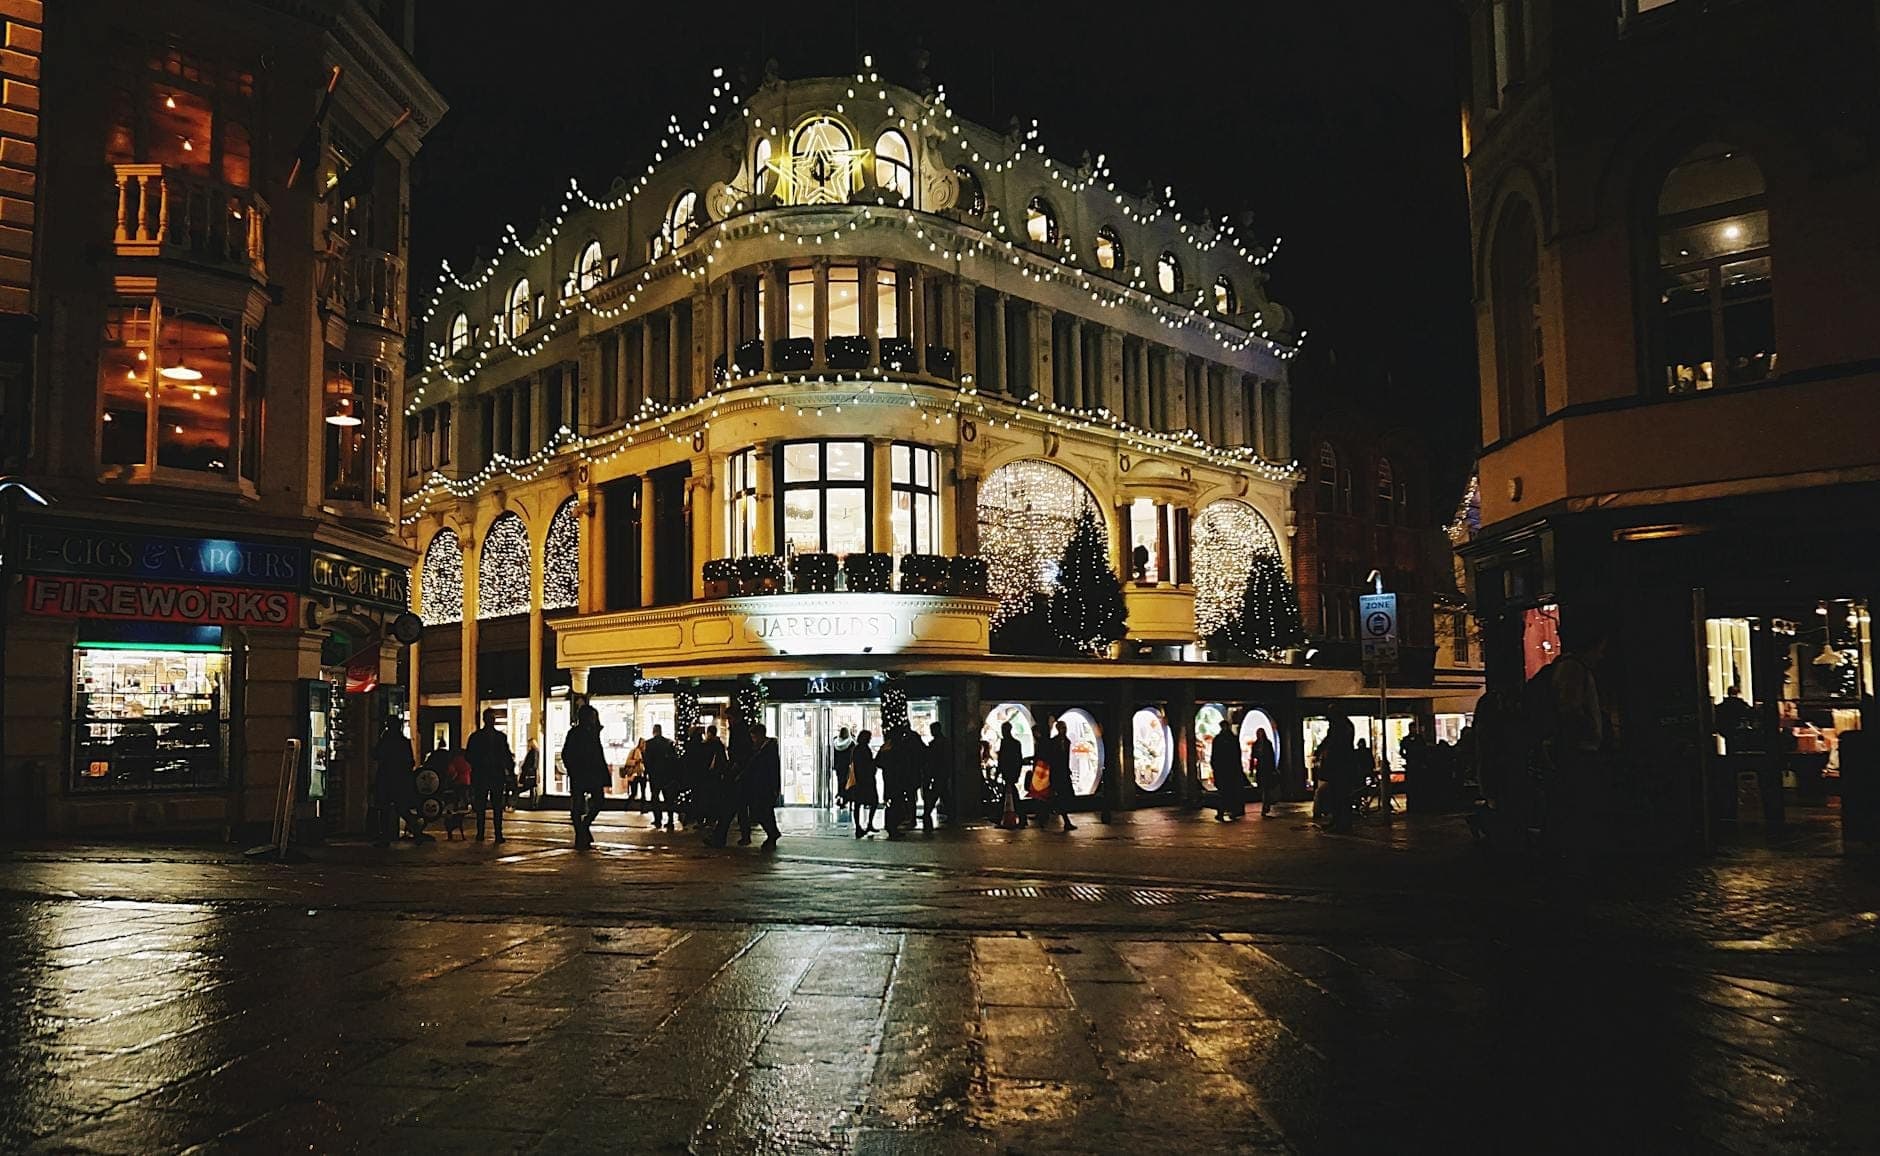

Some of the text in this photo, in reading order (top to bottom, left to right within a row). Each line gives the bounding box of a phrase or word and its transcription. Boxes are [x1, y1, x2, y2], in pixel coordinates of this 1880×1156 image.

[25, 533, 296, 578] E-CIGS & VAPOURS
[313, 558, 346, 589] CIGS
[33, 581, 288, 623] FIREWORKS
[1366, 601, 1391, 610] ZONE
